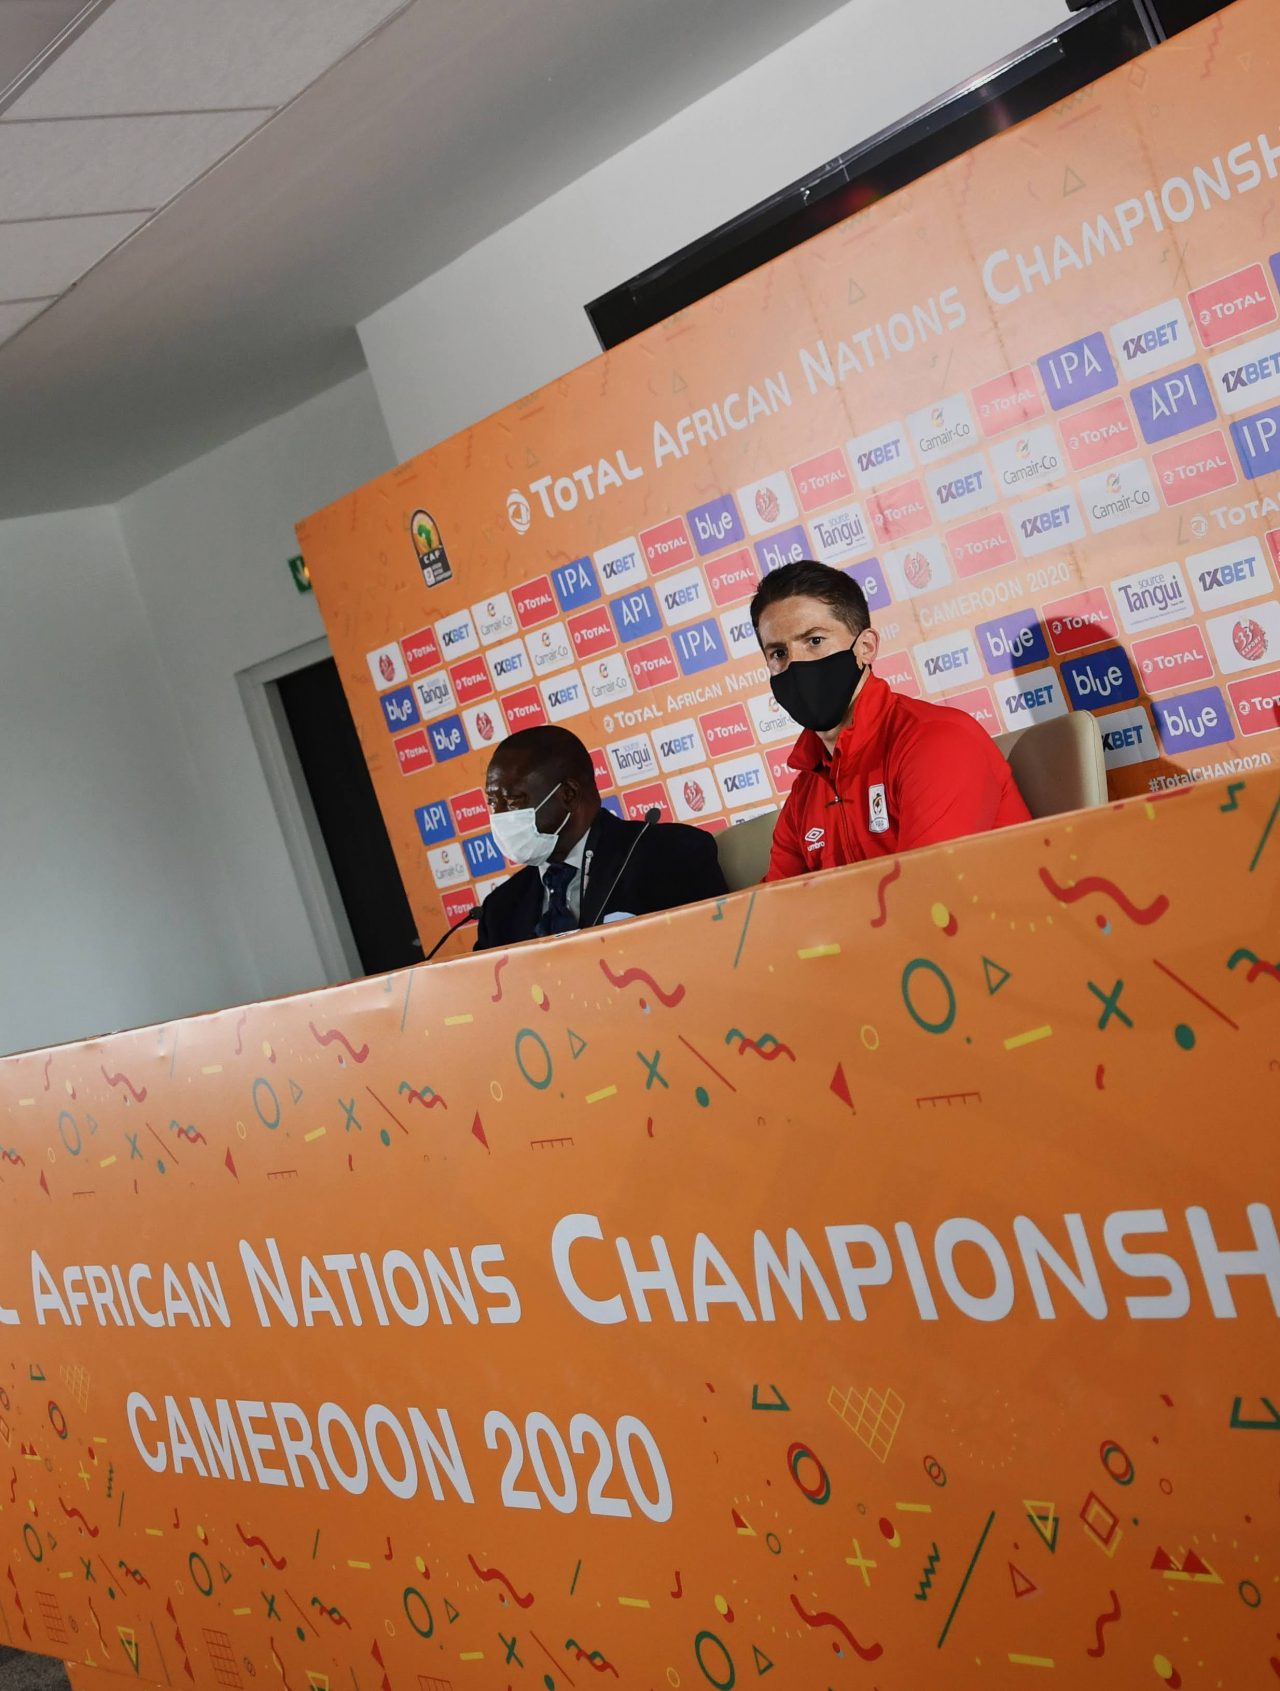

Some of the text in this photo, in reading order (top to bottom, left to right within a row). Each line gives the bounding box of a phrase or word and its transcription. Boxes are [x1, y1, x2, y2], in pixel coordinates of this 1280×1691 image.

[1212, 291, 1266, 319] TOTAL
[1123, 319, 1178, 361] 1XBET
[1049, 343, 1103, 390] IPA
[531, 449, 642, 520] TOTAL
[652, 372, 792, 468] AFRICAN
[800, 292, 967, 395] NATIONS
[992, 389, 1036, 412] TOTAL
[1152, 374, 1198, 421] API
[919, 422, 970, 453] Camair-Co
[1081, 421, 1129, 444] TOTAL
[857, 438, 901, 472] 1XBET
[1175, 456, 1227, 479] TOTAL
[810, 469, 846, 490] TOTAL
[1003, 455, 1058, 485] Camair-Co
[936, 470, 983, 505] 1XBET
[886, 502, 924, 521] TOTAL
[1092, 489, 1150, 520] Camair-Co
[695, 511, 733, 539] blue
[813, 514, 864, 549] Tangui
[1020, 505, 1071, 539] 1XBET
[655, 537, 687, 554] TOTAL
[965, 535, 1008, 554] TOTAL
[558, 563, 591, 597] IPA
[602, 552, 636, 579] 1XBET
[721, 567, 754, 586] TOTAL
[1199, 557, 1256, 592] 1XBET
[919, 577, 1024, 627] CAMEROON
[1028, 563, 1071, 593] 2020
[1118, 574, 1183, 613] Tangui
[1138, 573, 1166, 590] source
[525, 594, 552, 609] TOTAL
[622, 594, 651, 626] API
[665, 583, 700, 610] 1XBET
[581, 623, 611, 640] TOTAL
[1063, 610, 1109, 630] TOTAL
[679, 625, 717, 659] IPA
[986, 626, 1034, 658] blue
[641, 657, 672, 672] TOTAL
[925, 646, 969, 676] 1XBET
[1154, 650, 1204, 670] TOTAL
[1072, 665, 1123, 696] blue
[514, 703, 541, 718] TOTAL
[614, 666, 771, 727] TOTAL AFRICAN NATIO
[1005, 684, 1054, 714] 1XBET
[713, 722, 748, 739] TOTAL
[1163, 706, 1218, 738] blue
[433, 727, 461, 751] blue
[660, 733, 695, 758] 1XBET
[611, 744, 651, 771] Tangui
[1150, 753, 1270, 790] #TotalCHAN2020
[724, 768, 761, 793] 1XBET
[424, 805, 447, 832] API
[469, 839, 498, 865] IPA
[31, 1250, 231, 1328] AFRICAN
[239, 1238, 521, 1327] NATIONS
[126, 1392, 673, 1523] CAMEROON 2020
